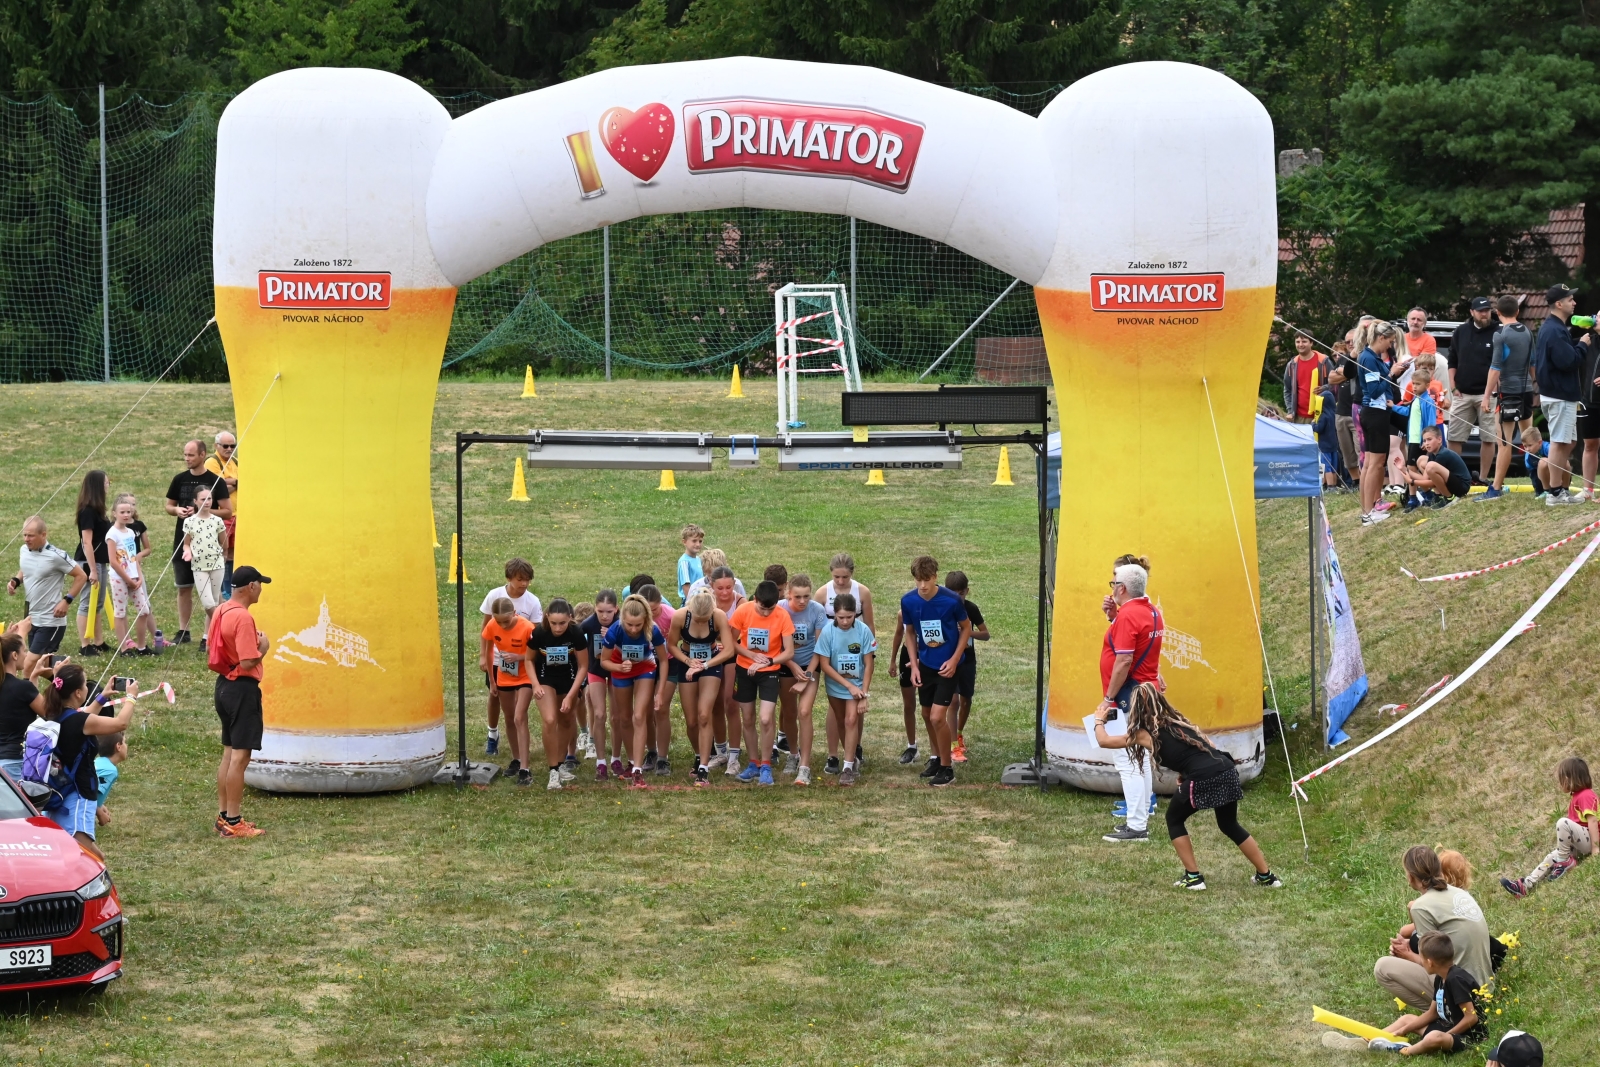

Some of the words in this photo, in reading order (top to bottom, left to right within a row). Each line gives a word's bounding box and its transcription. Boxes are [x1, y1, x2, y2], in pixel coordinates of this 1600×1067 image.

[697, 108, 904, 175] PRIMÁTOR
[293, 258, 330, 267] Založeno
[333, 259, 352, 267] 1872
[1128, 261, 1165, 269] Založeno
[1168, 261, 1188, 269] 1872
[265, 276, 383, 302] PRIMÁTOR
[1098, 279, 1217, 305] PRIMÁTOR
[282, 315, 319, 323] PIVOVAR
[324, 313, 364, 323] NÁCHOD
[1159, 316, 1199, 325] NÁCHOD
[792, 632, 805, 641] 43
[924, 629, 941, 638] 250
[750, 636, 765, 646] 251
[548, 654, 566, 662] 253
[693, 651, 708, 660] 153
[841, 662, 856, 671] 156
[10, 948, 44, 966] S923
